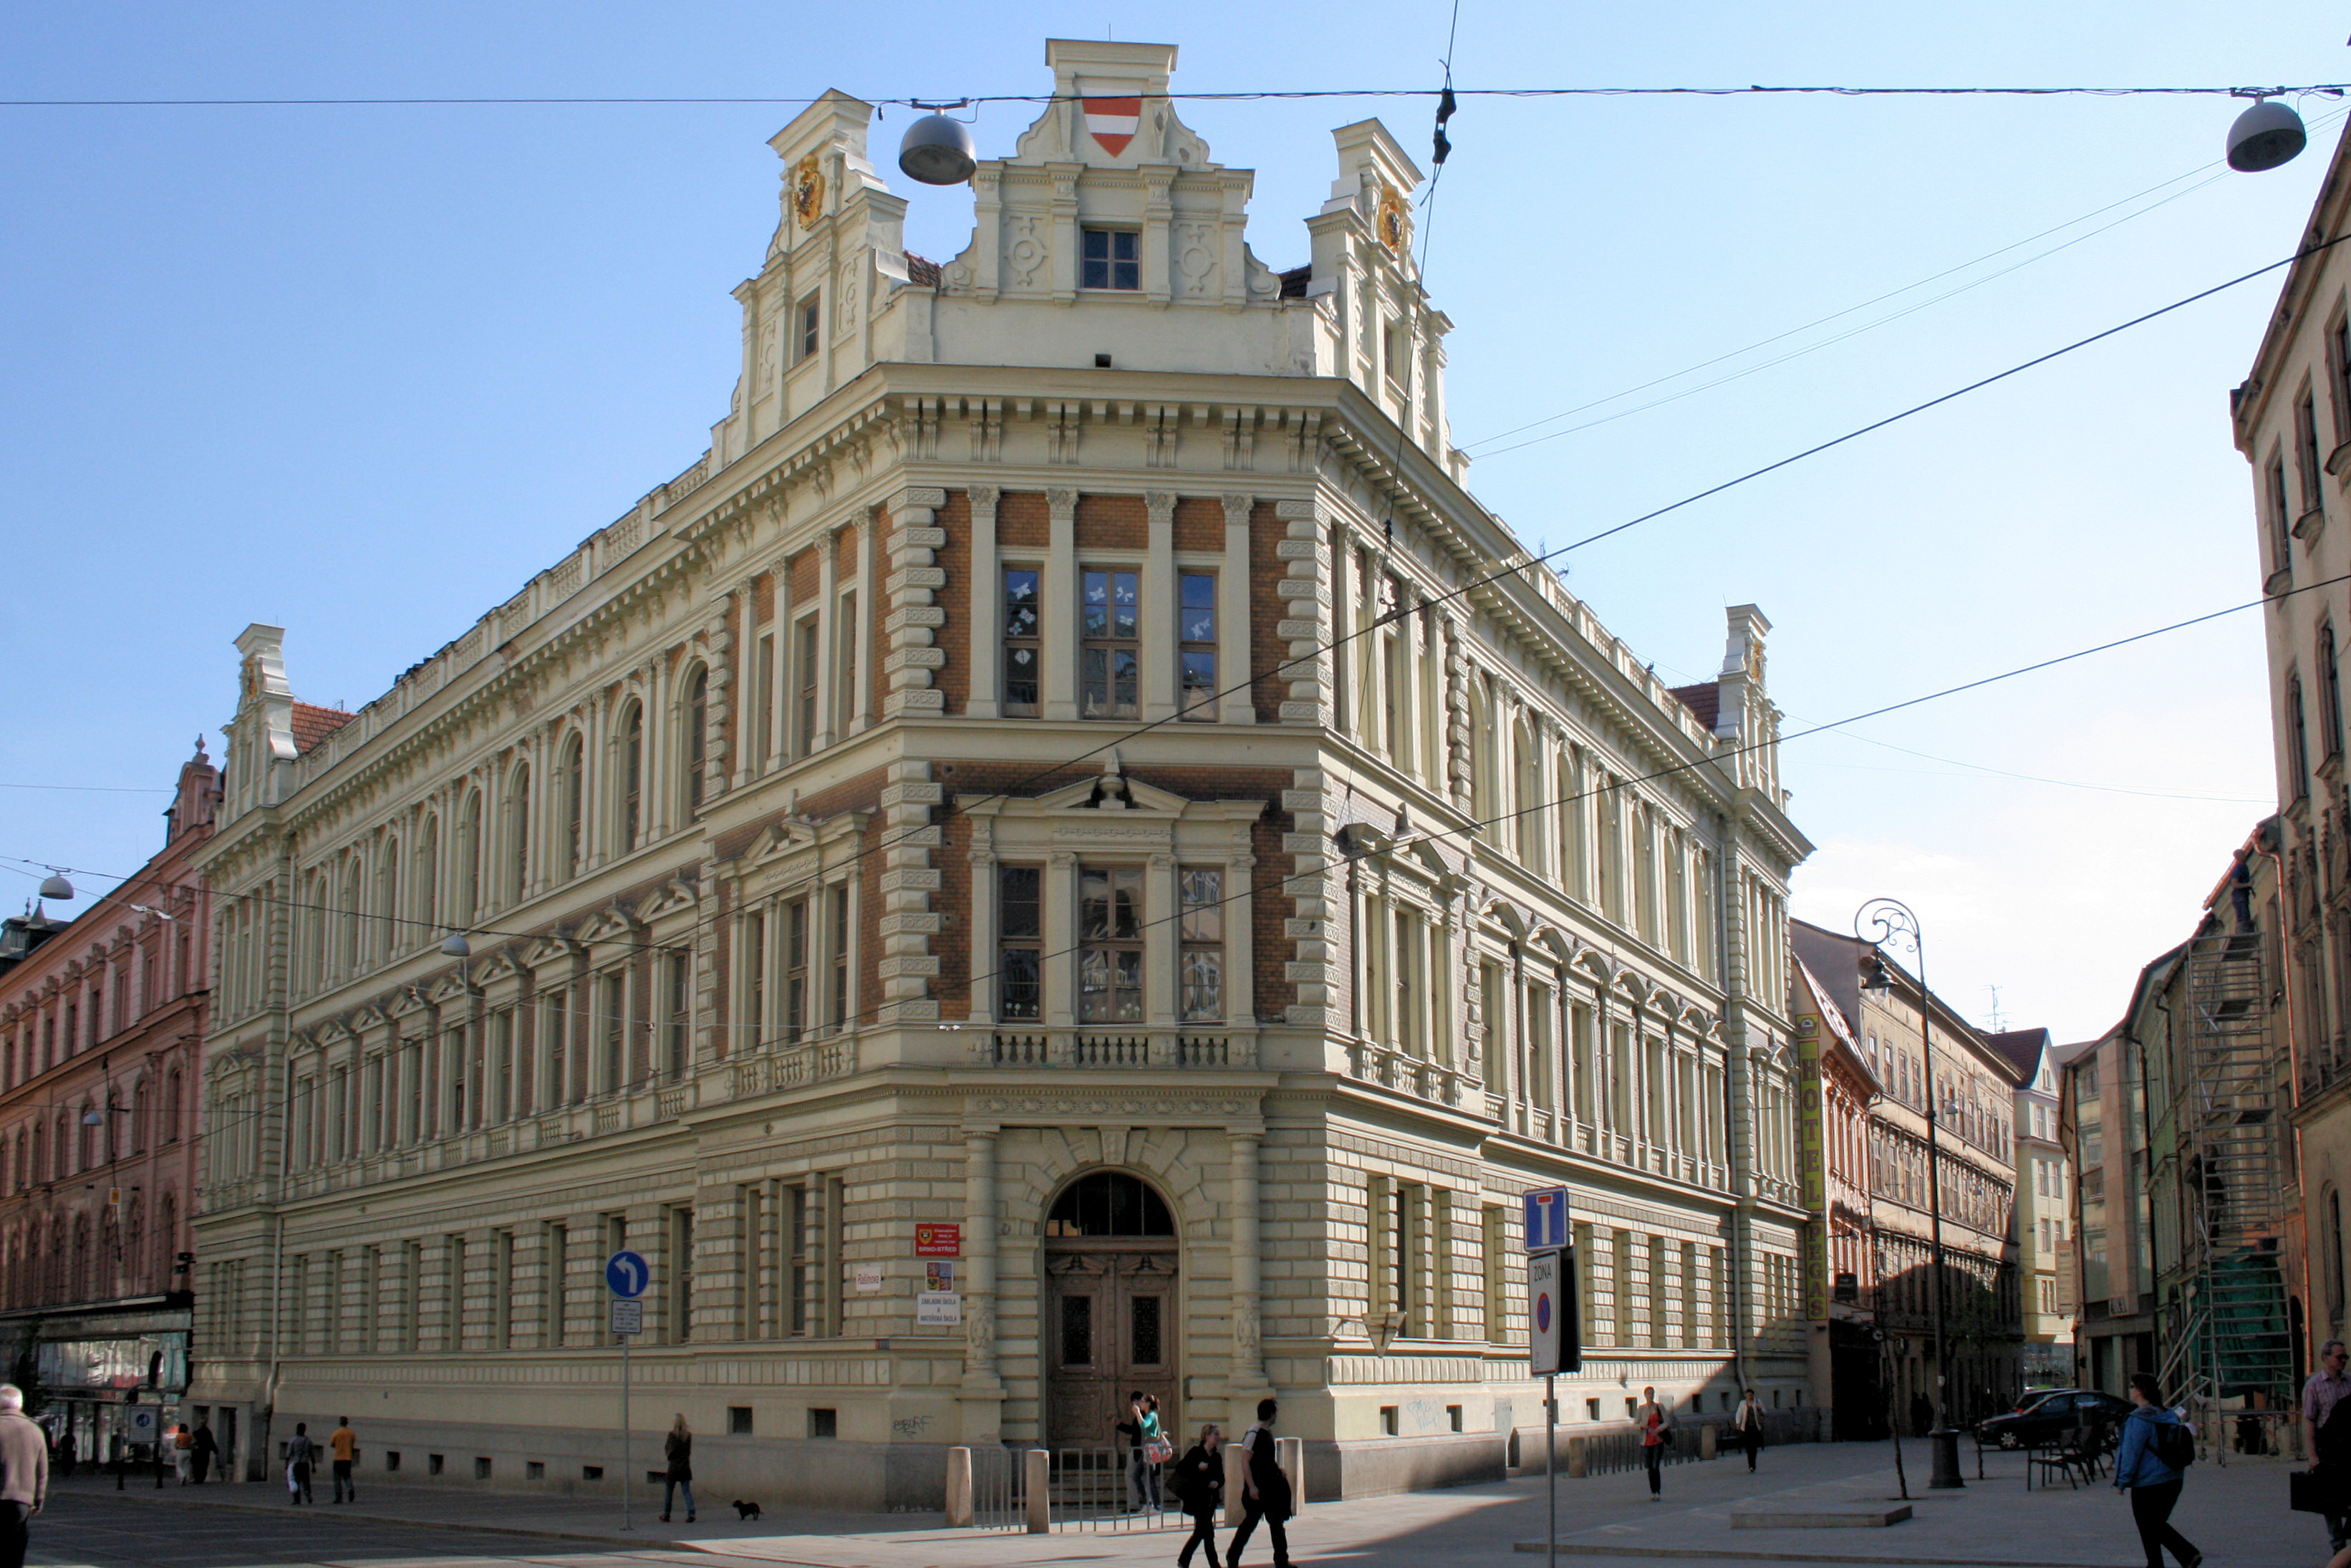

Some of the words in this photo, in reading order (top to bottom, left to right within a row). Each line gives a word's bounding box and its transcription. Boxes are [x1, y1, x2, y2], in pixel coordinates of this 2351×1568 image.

[1802, 1058, 1820, 1203] HOTEL
[1534, 1261, 1552, 1281] ZÓNA
[1808, 1225, 1824, 1317] PEGAS
